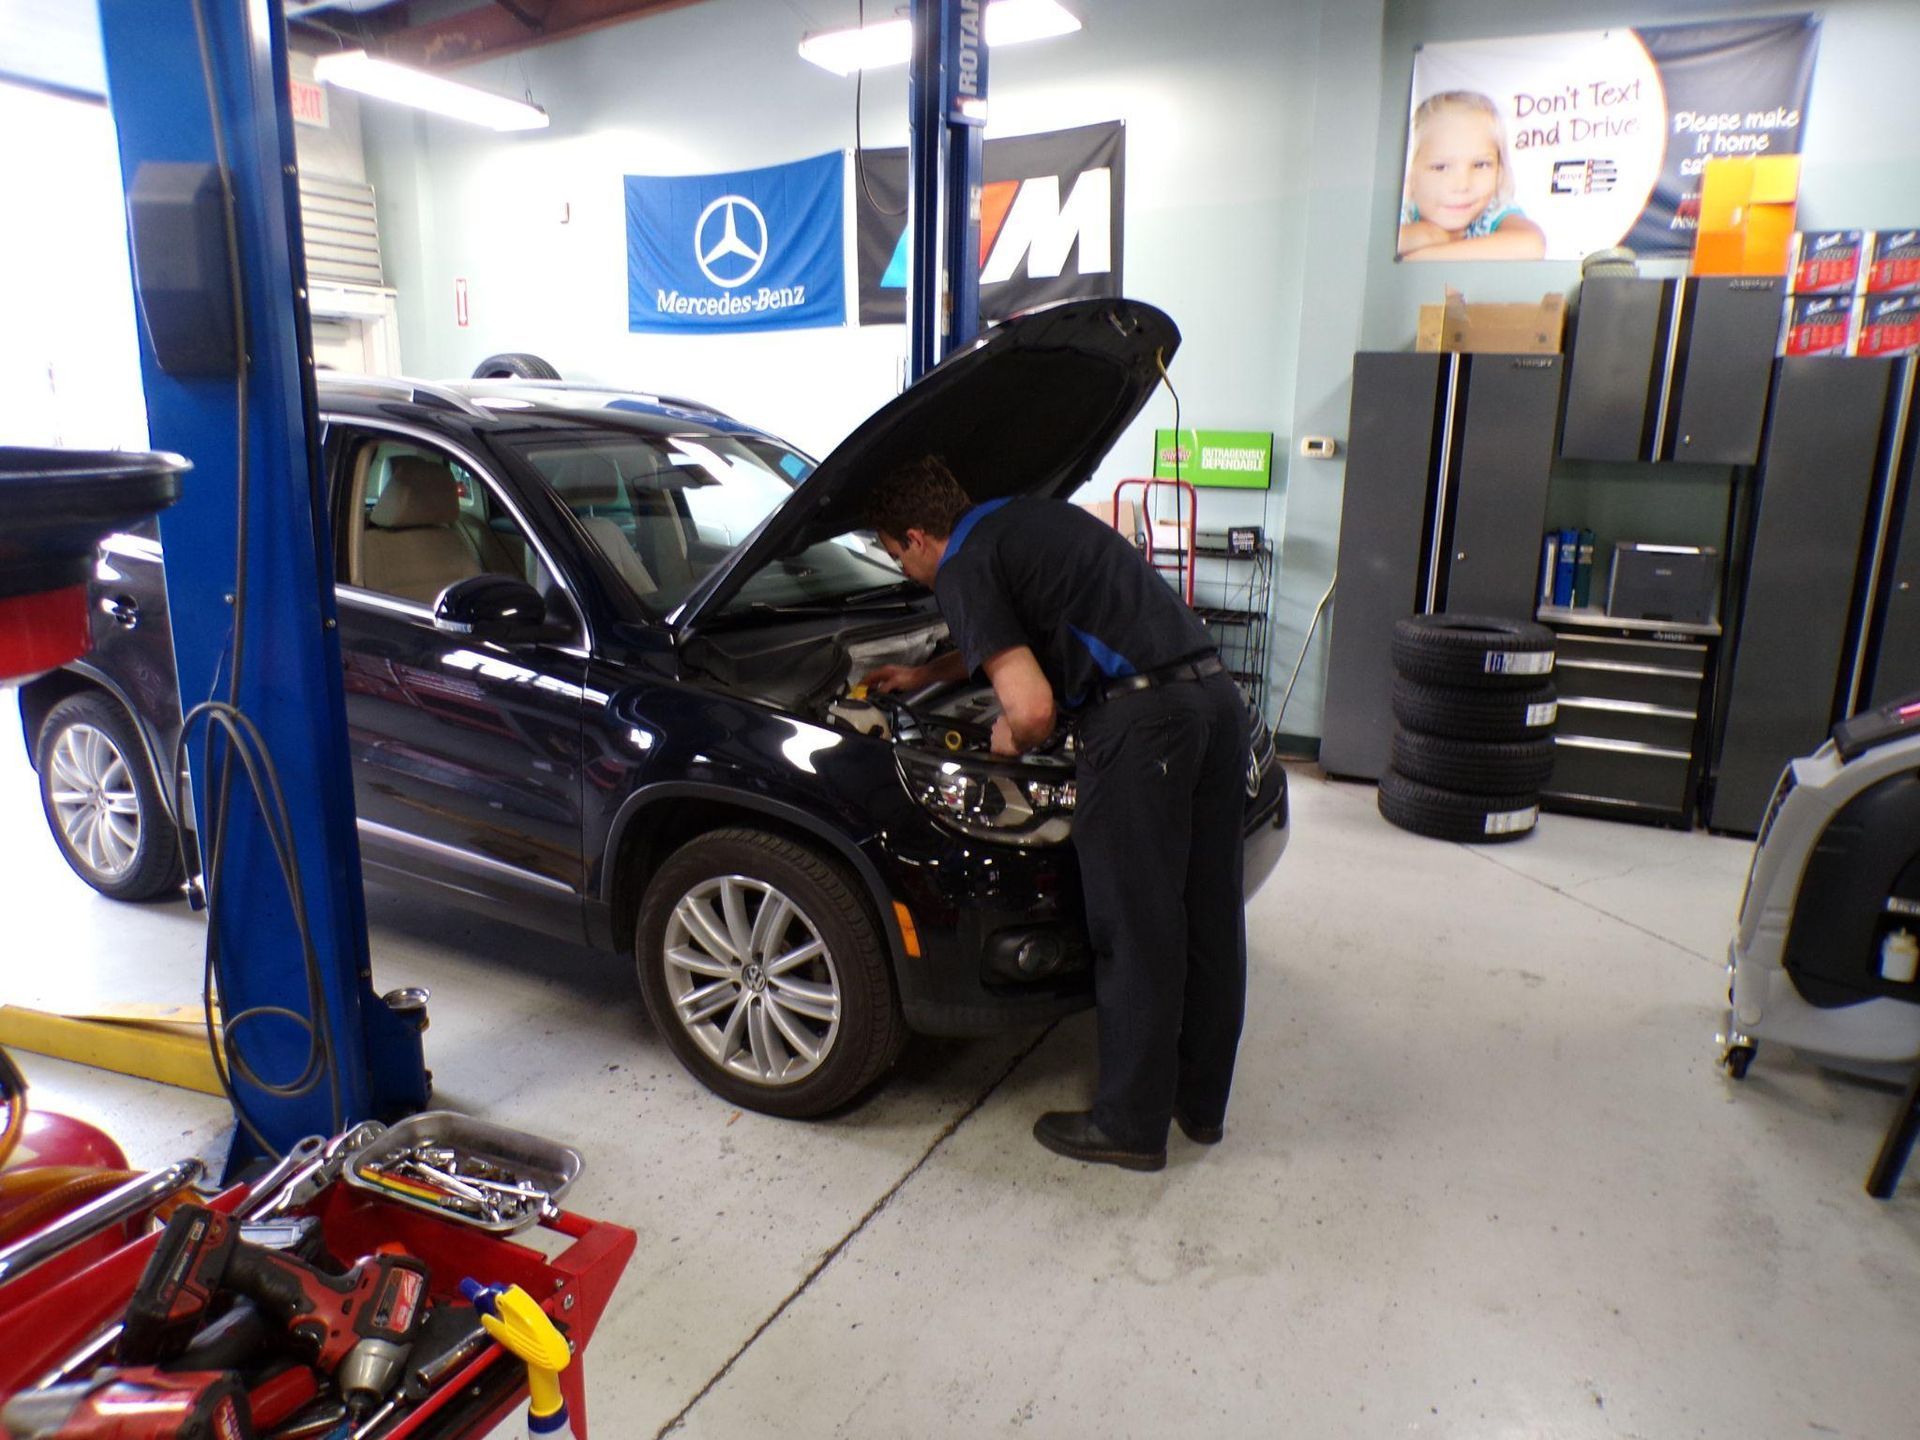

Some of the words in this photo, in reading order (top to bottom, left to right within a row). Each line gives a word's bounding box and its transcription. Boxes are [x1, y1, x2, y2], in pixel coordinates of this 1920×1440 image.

[292, 82, 321, 120] EXIT
[1514, 86, 1579, 118] Don't
[1588, 78, 1641, 106] Text
[1515, 121, 1560, 150] and
[1569, 116, 1639, 141] Drive
[1674, 111, 1740, 133] Please
[1745, 106, 1799, 129] make
[1714, 132, 1769, 152] home
[980, 166, 1112, 285] M
[657, 286, 805, 316] Mercedes-Benz
[1201, 457, 1265, 471] DEPENDABLE
[1202, 447, 1267, 461] OUTRAGEOUSLY
